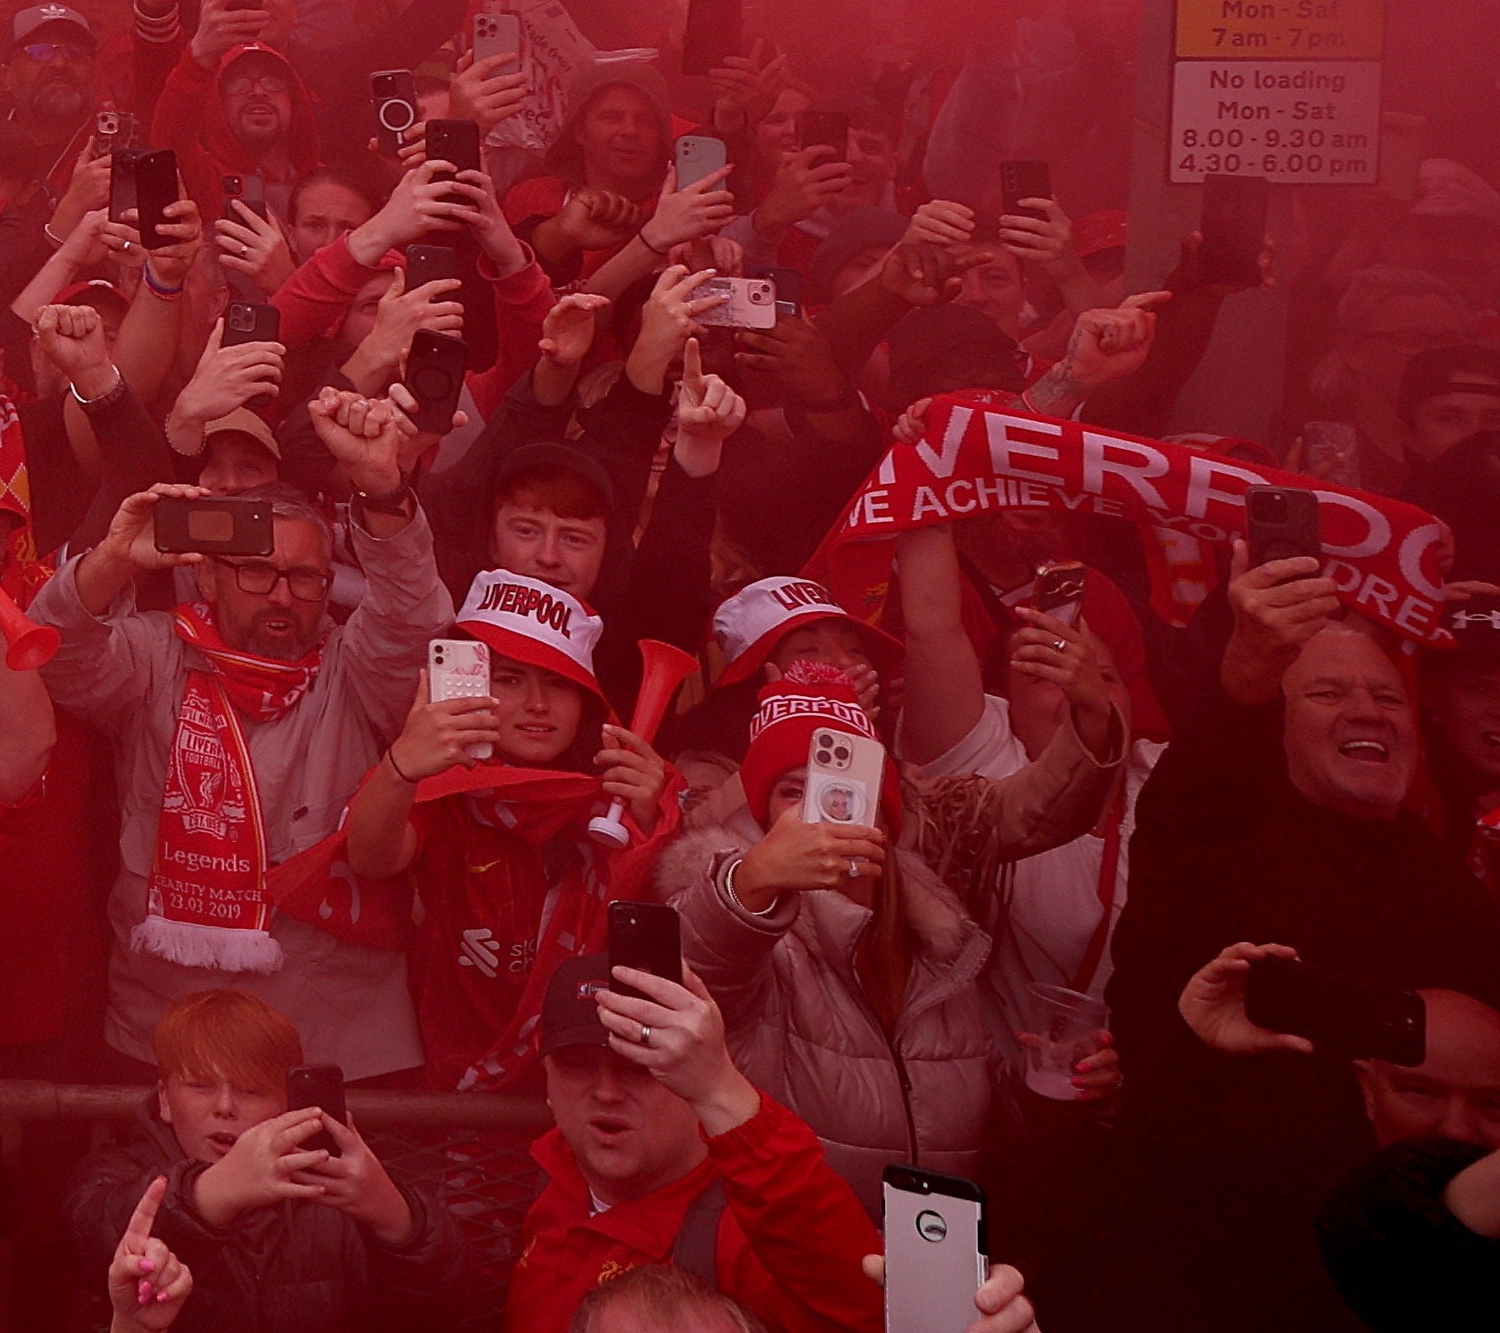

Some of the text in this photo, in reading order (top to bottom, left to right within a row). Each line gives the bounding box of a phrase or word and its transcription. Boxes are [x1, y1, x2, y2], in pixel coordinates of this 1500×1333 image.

[1221, 0, 1275, 18] Mon
[1296, 0, 1340, 19] Sat
[1209, 69, 1346, 93] No loading
[1216, 101, 1270, 120] Mon
[1291, 101, 1336, 120] Sat
[1182, 129, 1244, 148] 8.00
[1265, 129, 1324, 148] 9.30
[1179, 153, 1241, 173] 4.30
[1261, 153, 1323, 173] 6.00
[911, 476, 1126, 520] ACHIEVE
[476, 582, 572, 639] LIVERPOOL
[163, 841, 251, 874] Legends
[209, 888, 263, 904] MATCH
